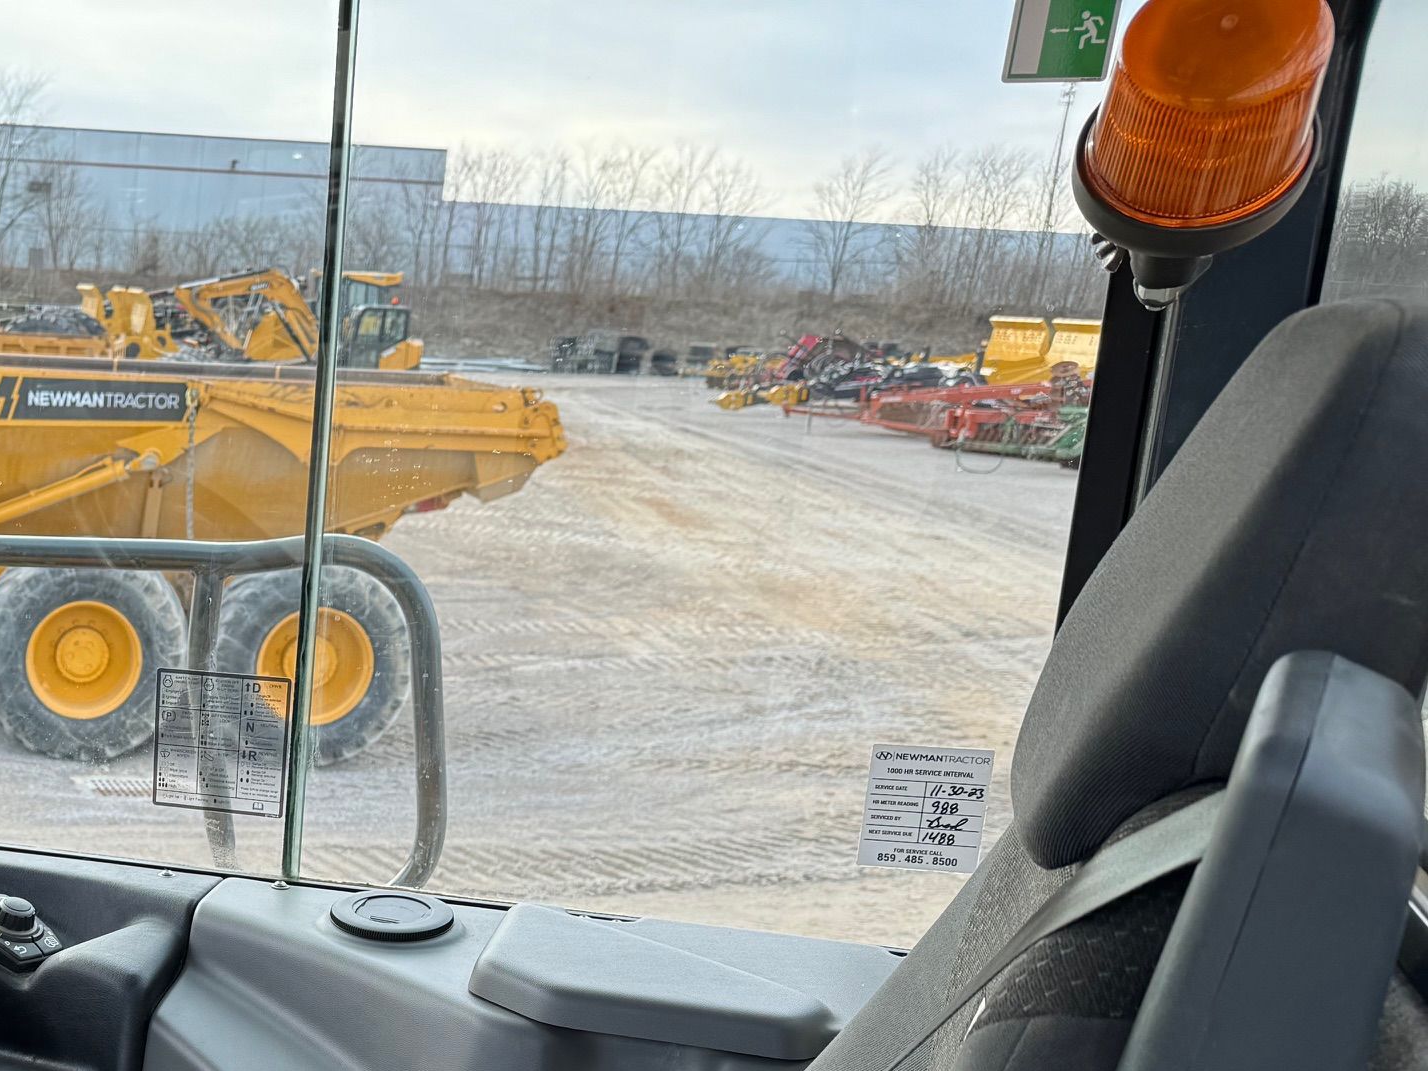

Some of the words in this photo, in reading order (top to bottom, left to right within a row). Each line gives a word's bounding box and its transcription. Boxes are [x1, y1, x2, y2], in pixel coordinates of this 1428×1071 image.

[27, 389, 180, 410] NEWMANTRACTOR
[252, 682, 261, 693] D
[246, 722, 255, 732] N
[248, 750, 257, 761] R
[895, 752, 991, 765] NEWMANTRACTOR
[887, 767, 903, 775] 1000
[915, 769, 942, 777] SERVICE
[943, 771, 974, 779] INTERVAL
[931, 800, 959, 815] 988
[922, 831, 955, 846] 1488
[906, 848, 928, 856] SERVICE
